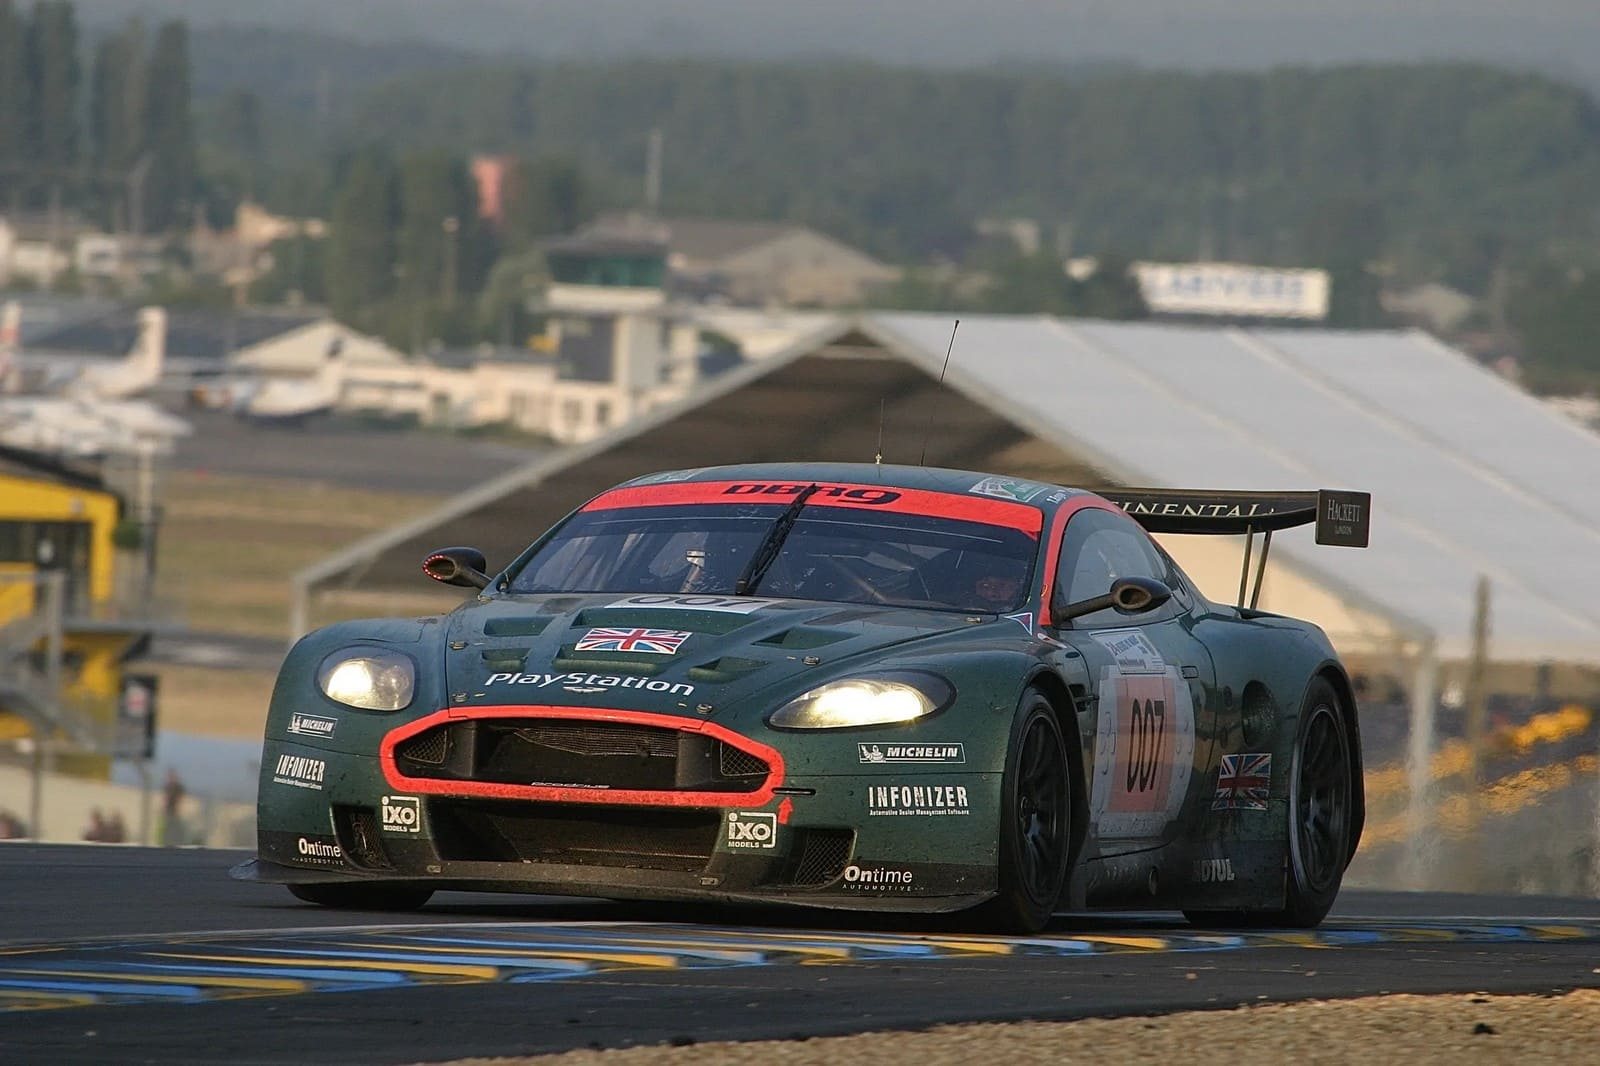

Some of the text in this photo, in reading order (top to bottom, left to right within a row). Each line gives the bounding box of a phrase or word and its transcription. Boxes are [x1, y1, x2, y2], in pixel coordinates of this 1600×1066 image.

[1327, 499, 1361, 522] HACKETT
[628, 595, 770, 607] 007
[484, 672, 696, 697] PlayStation
[301, 718, 334, 732] MICHELIN
[887, 747, 958, 758] MICHELIN
[1126, 698, 1165, 793] 007
[275, 754, 326, 782] INFONIZER
[868, 786, 969, 807] INFONIZER
[298, 838, 341, 858] Ontime
[844, 865, 913, 883] Ontime
[1193, 859, 1235, 882] OTUL
[842, 884, 911, 892] AUTOMOTIVE
